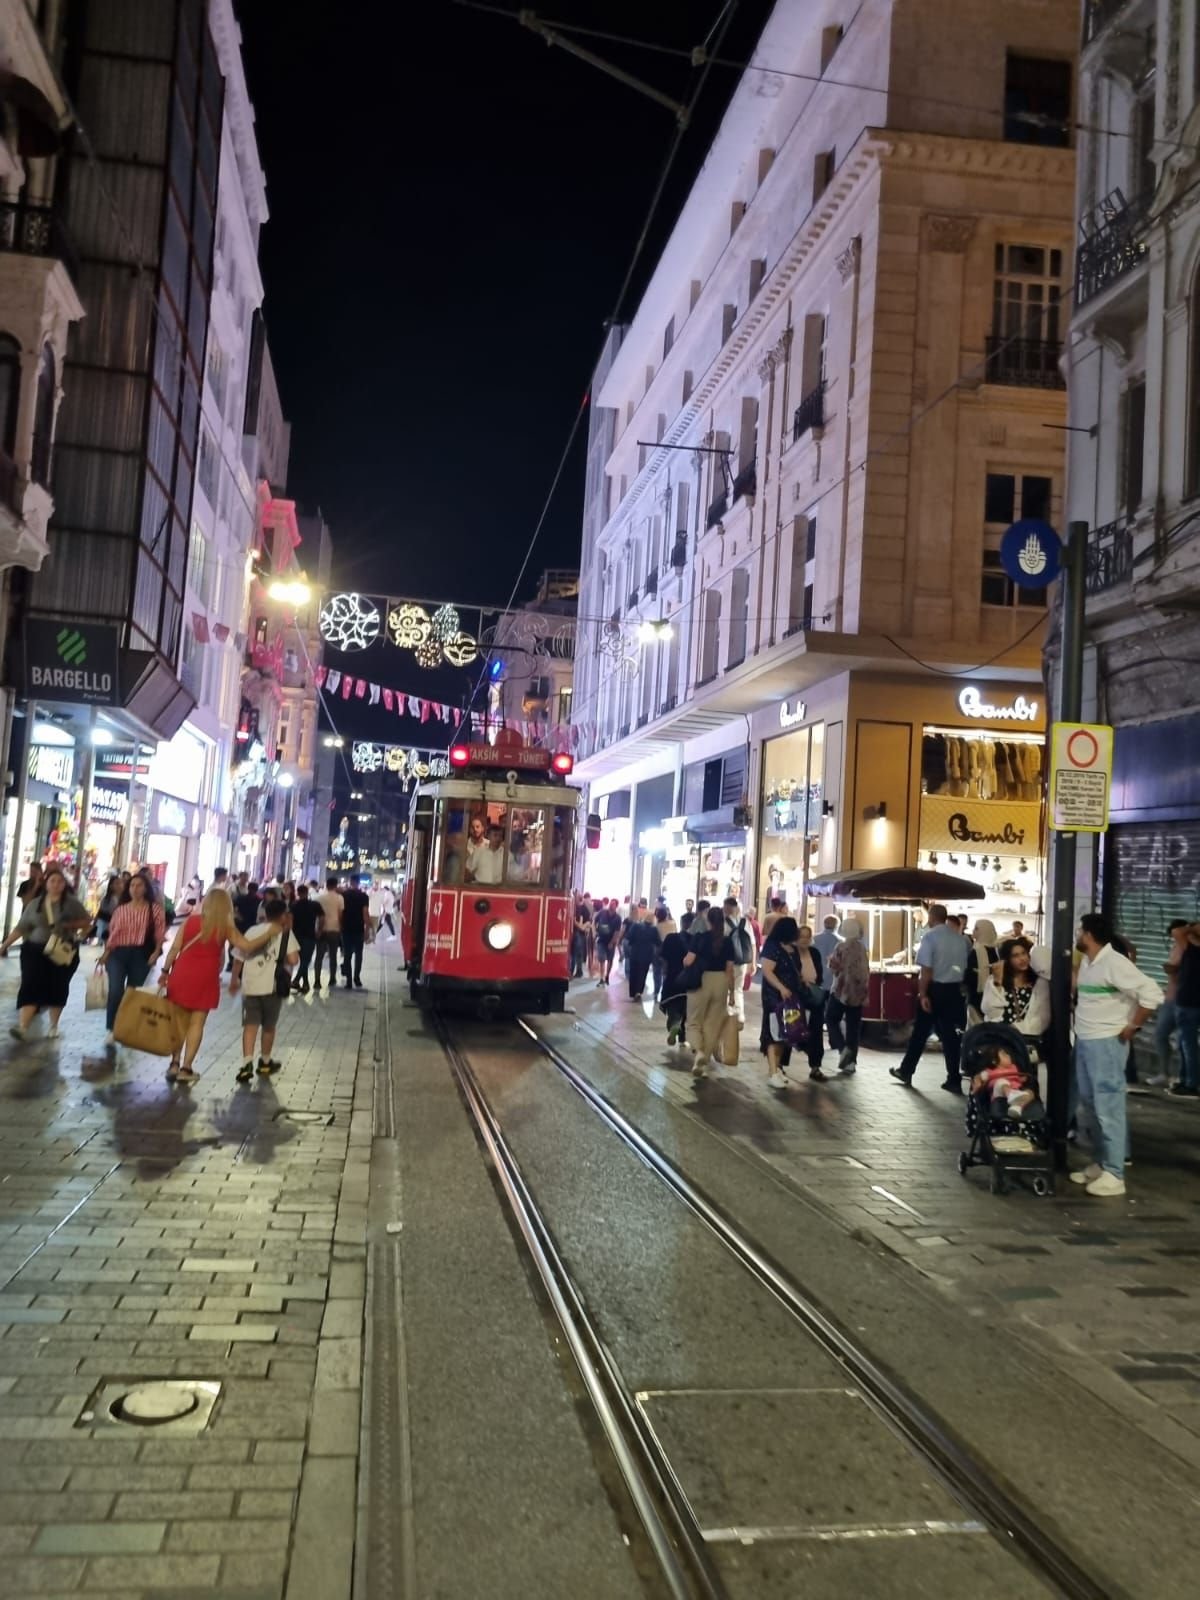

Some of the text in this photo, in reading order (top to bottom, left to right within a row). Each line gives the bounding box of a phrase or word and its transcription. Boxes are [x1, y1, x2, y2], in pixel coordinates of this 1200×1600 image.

[32, 666, 111, 692] BARGELLO
[959, 686, 1038, 721] Bambi
[519, 750, 545, 765] TÜNEL
[948, 813, 1025, 845] Bambi
[557, 907, 567, 922] 47
